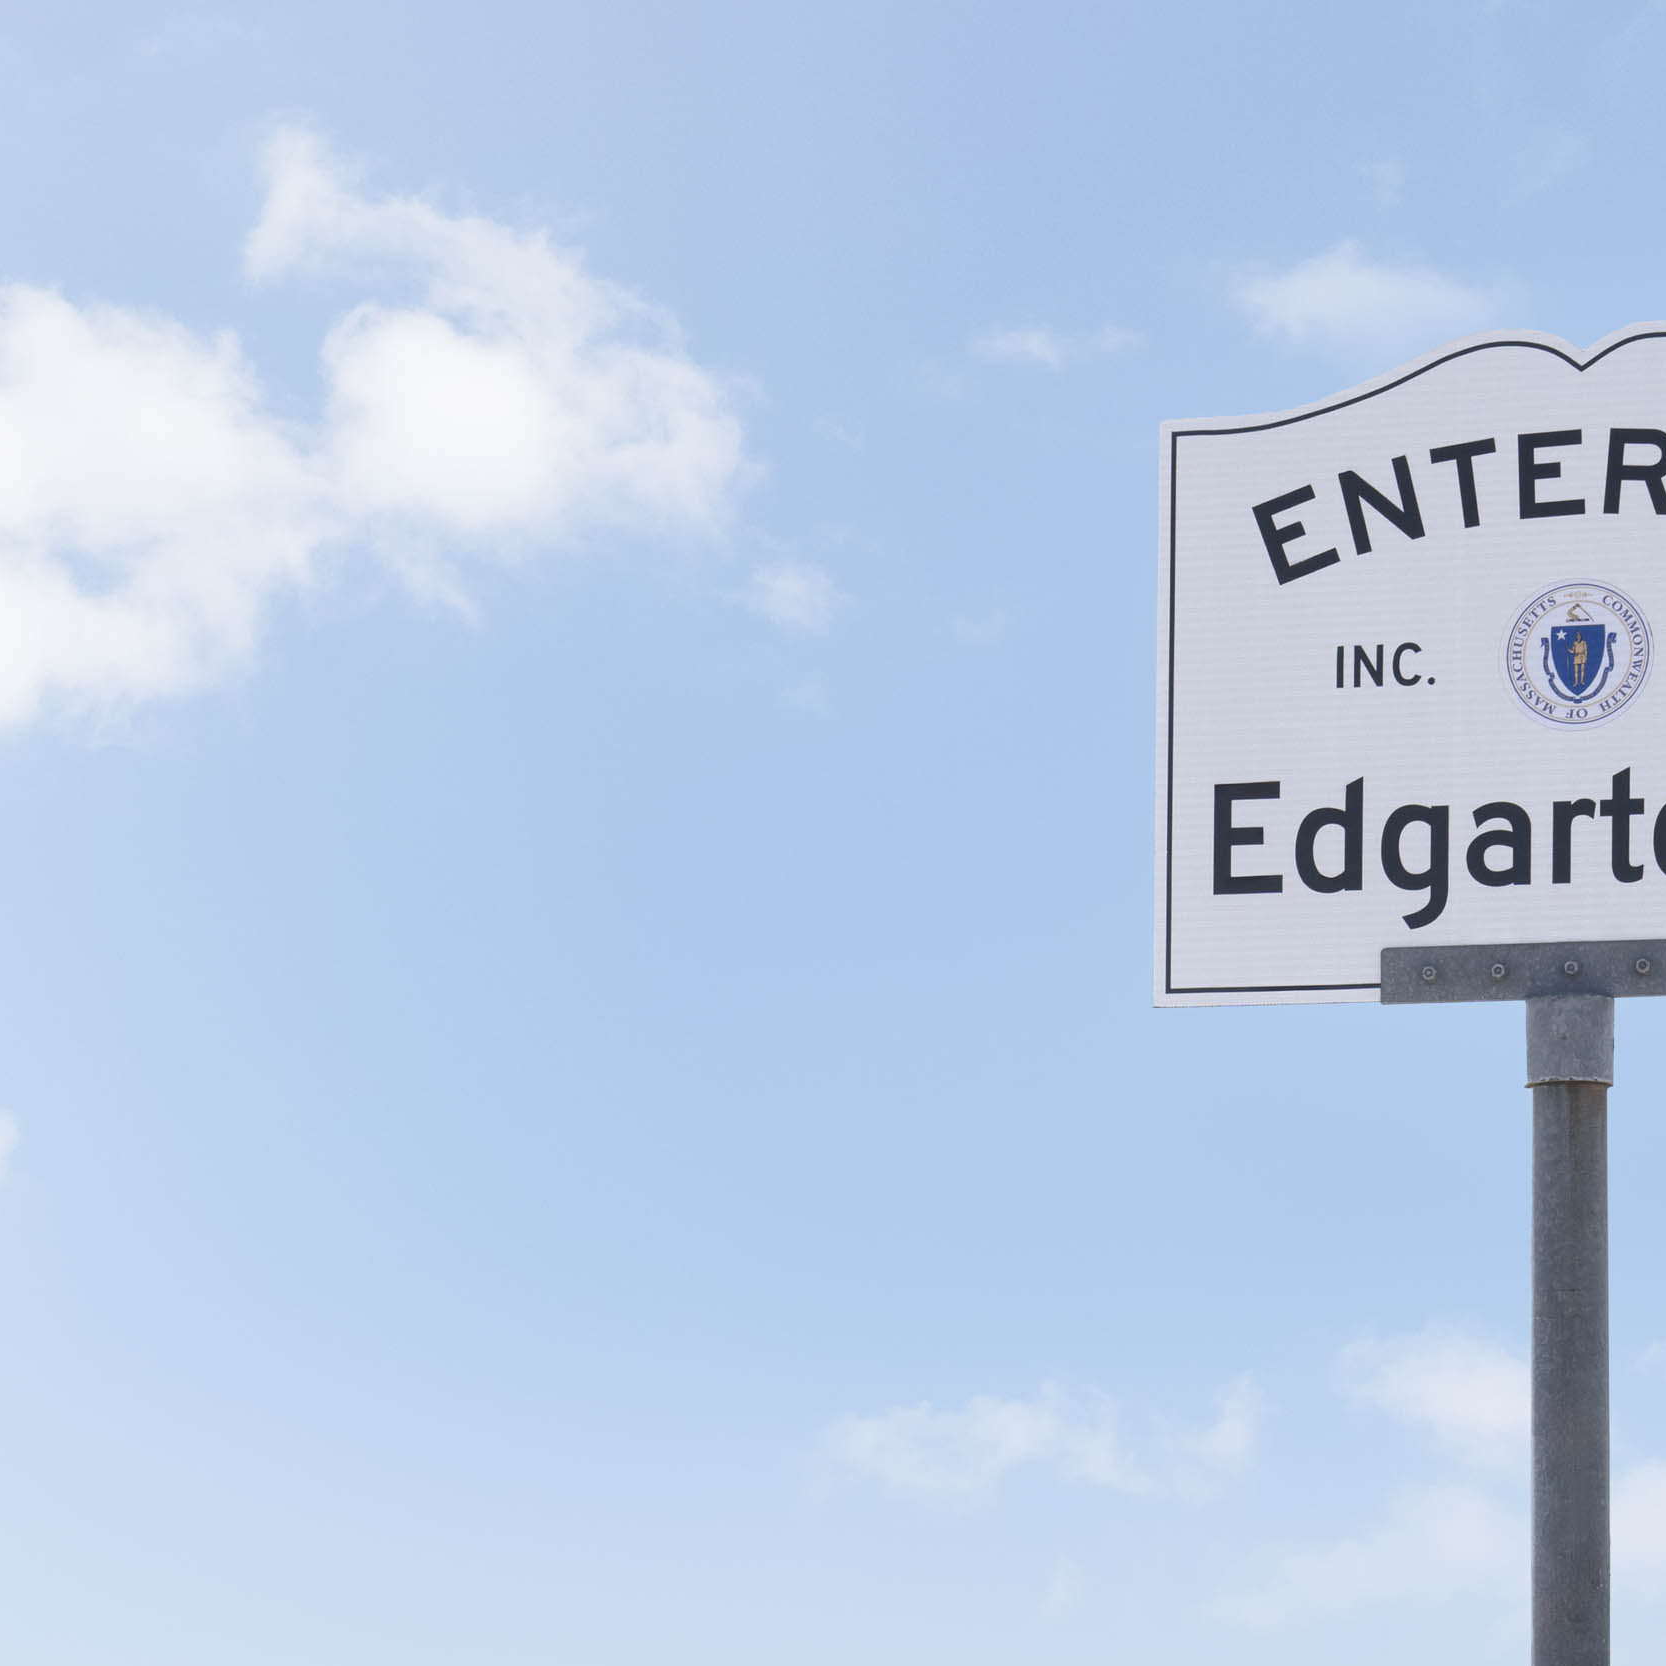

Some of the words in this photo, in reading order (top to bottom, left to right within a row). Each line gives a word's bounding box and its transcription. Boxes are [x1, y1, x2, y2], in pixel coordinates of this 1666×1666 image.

[1335, 642, 1437, 689] INC.
[1511, 595, 1557, 715] MASSACHUSETTS
[1599, 594, 1645, 713] COMMONWEALTH
[1565, 707, 1588, 719] OF
